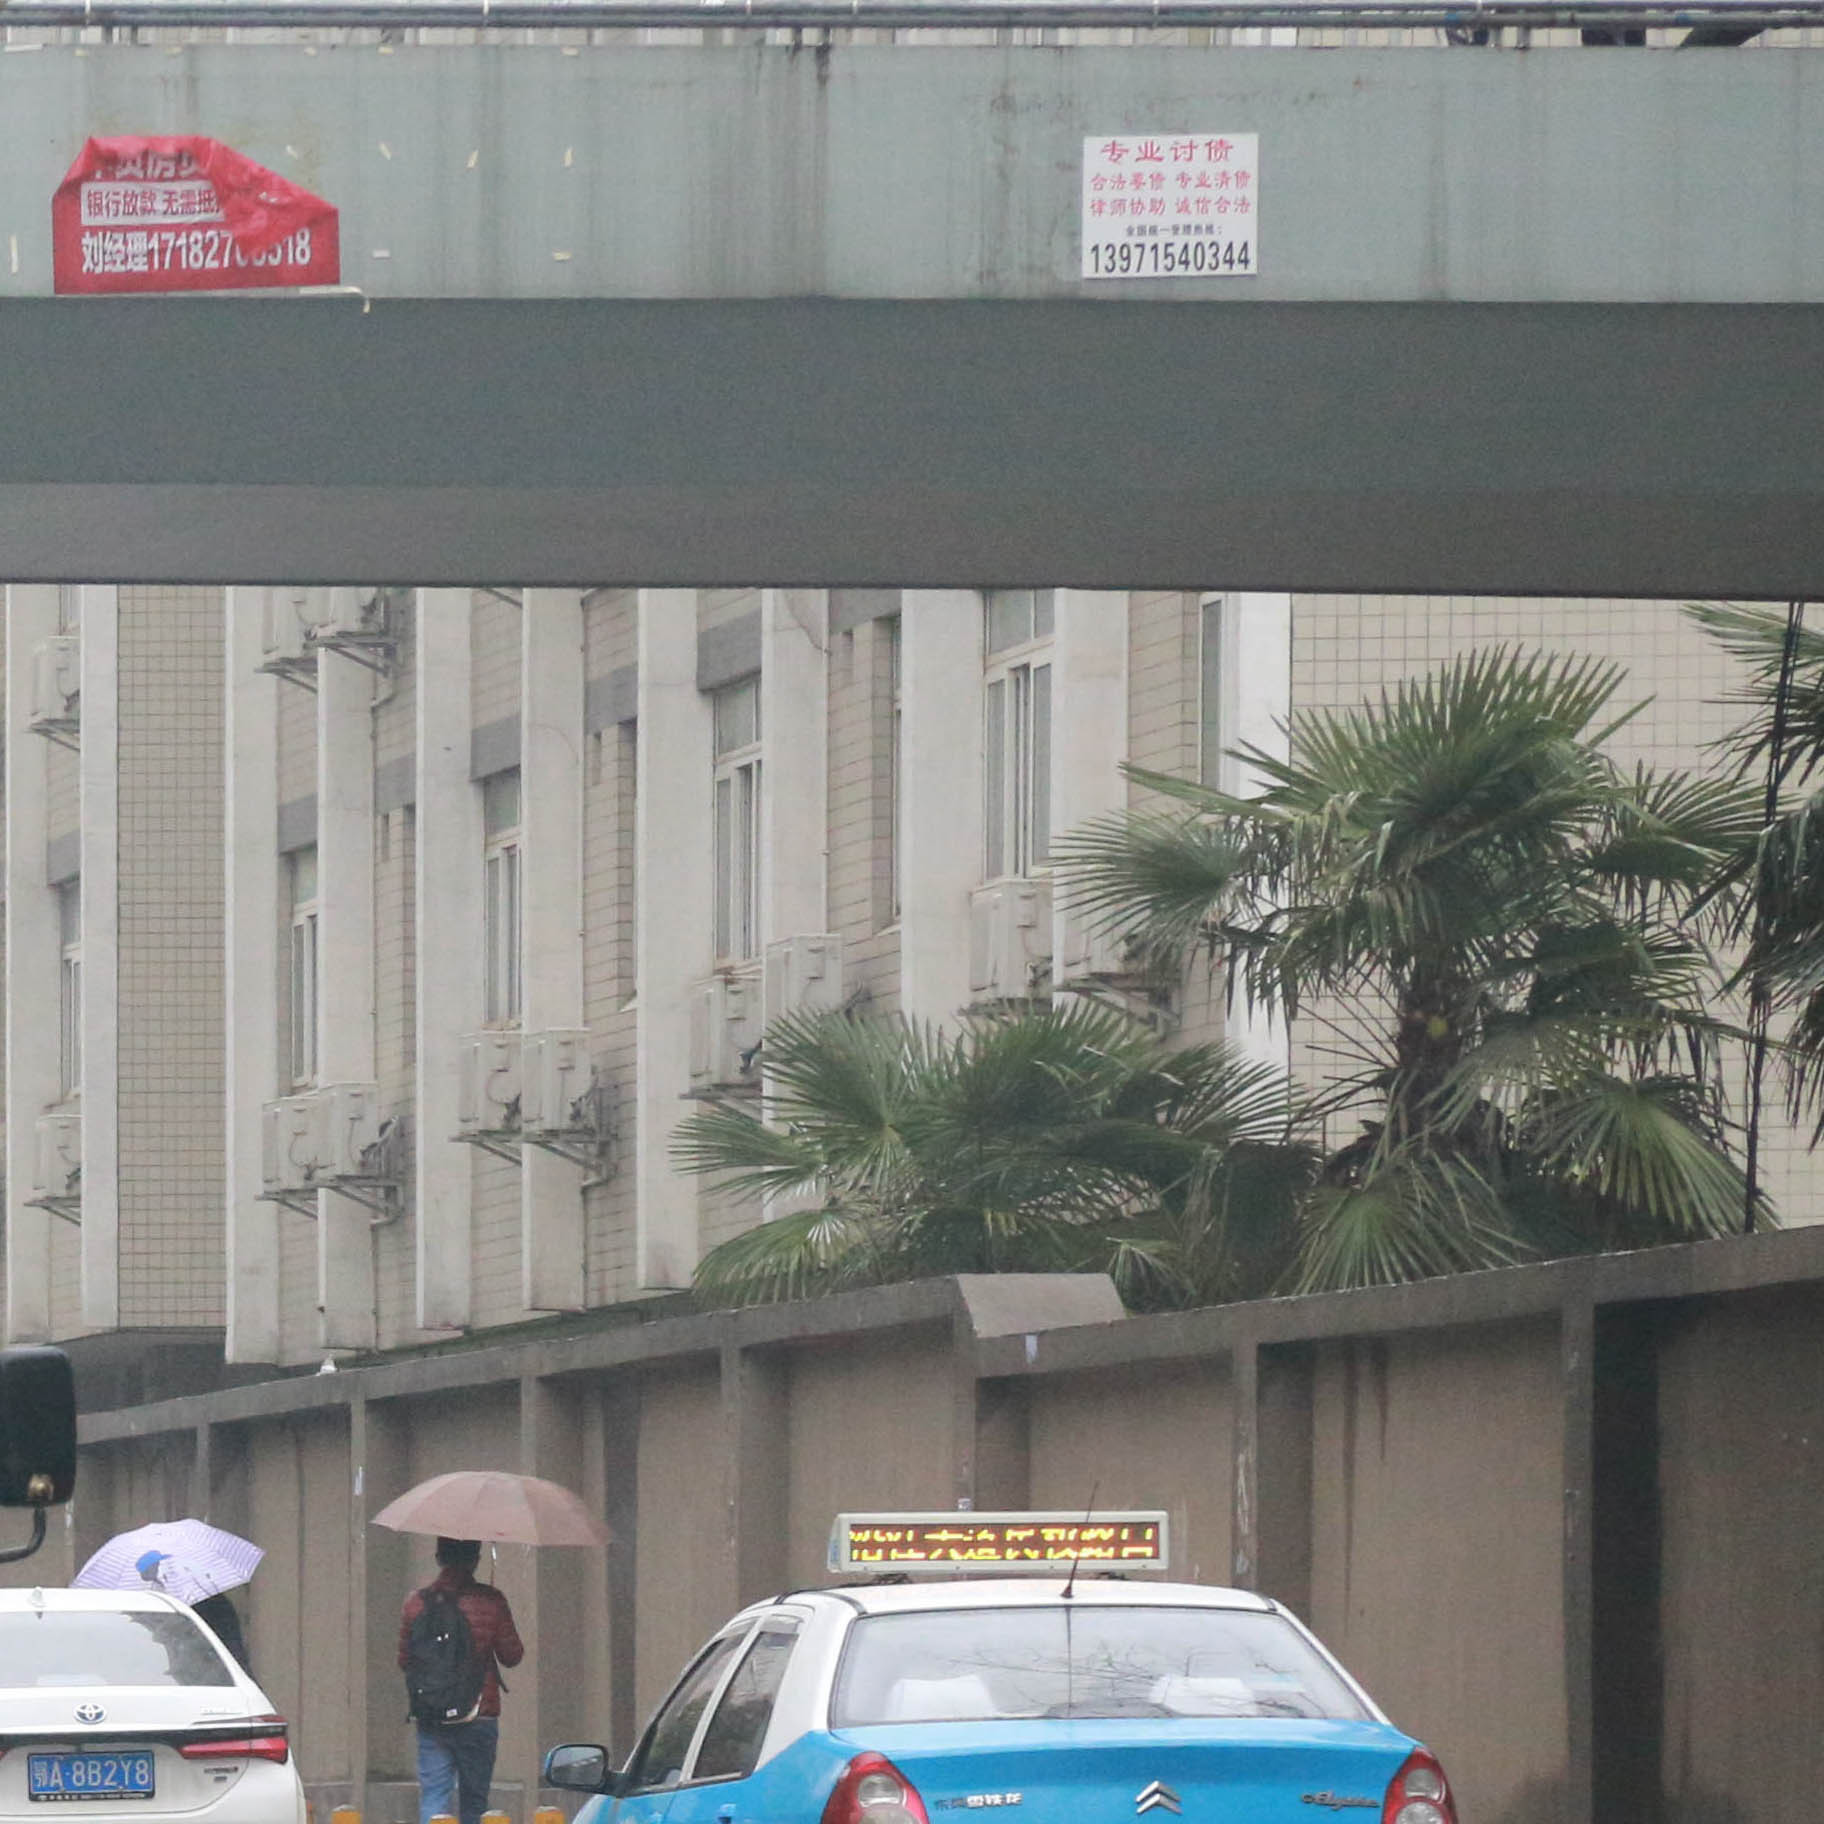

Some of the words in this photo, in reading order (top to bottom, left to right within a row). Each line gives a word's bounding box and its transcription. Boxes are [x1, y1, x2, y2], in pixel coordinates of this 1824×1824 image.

[1100, 138, 1234, 164] 专业讨债
[87, 189, 157, 217] 银行放款
[1090, 197, 1166, 216] 律师协助
[1175, 196, 1251, 215] 诚信合法
[1090, 240, 1250, 274] 13971540344
